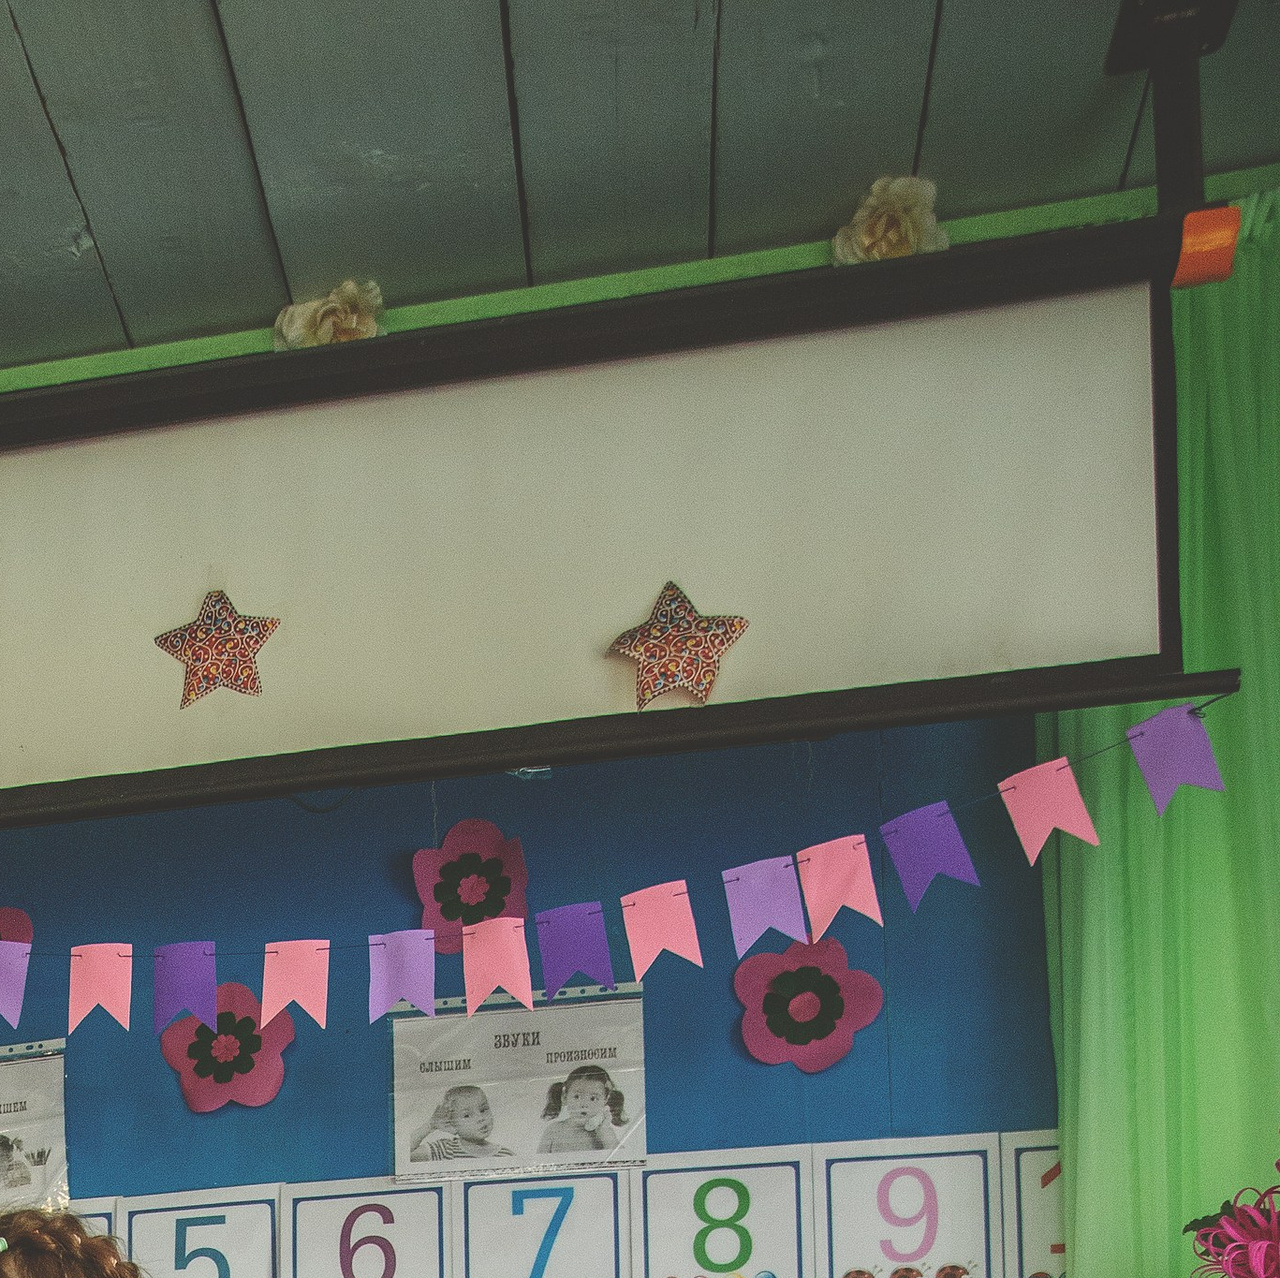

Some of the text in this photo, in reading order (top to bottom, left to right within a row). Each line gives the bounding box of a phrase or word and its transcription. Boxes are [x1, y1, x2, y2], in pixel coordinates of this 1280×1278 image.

[493, 1031, 541, 1049] ЗВУКИ
[546, 1047, 617, 1064] ПРОИЗНОСИМ
[419, 1058, 472, 1073] СЛЫШИМ
[877, 1166, 939, 1263] 9
[692, 1177, 754, 1274] 8
